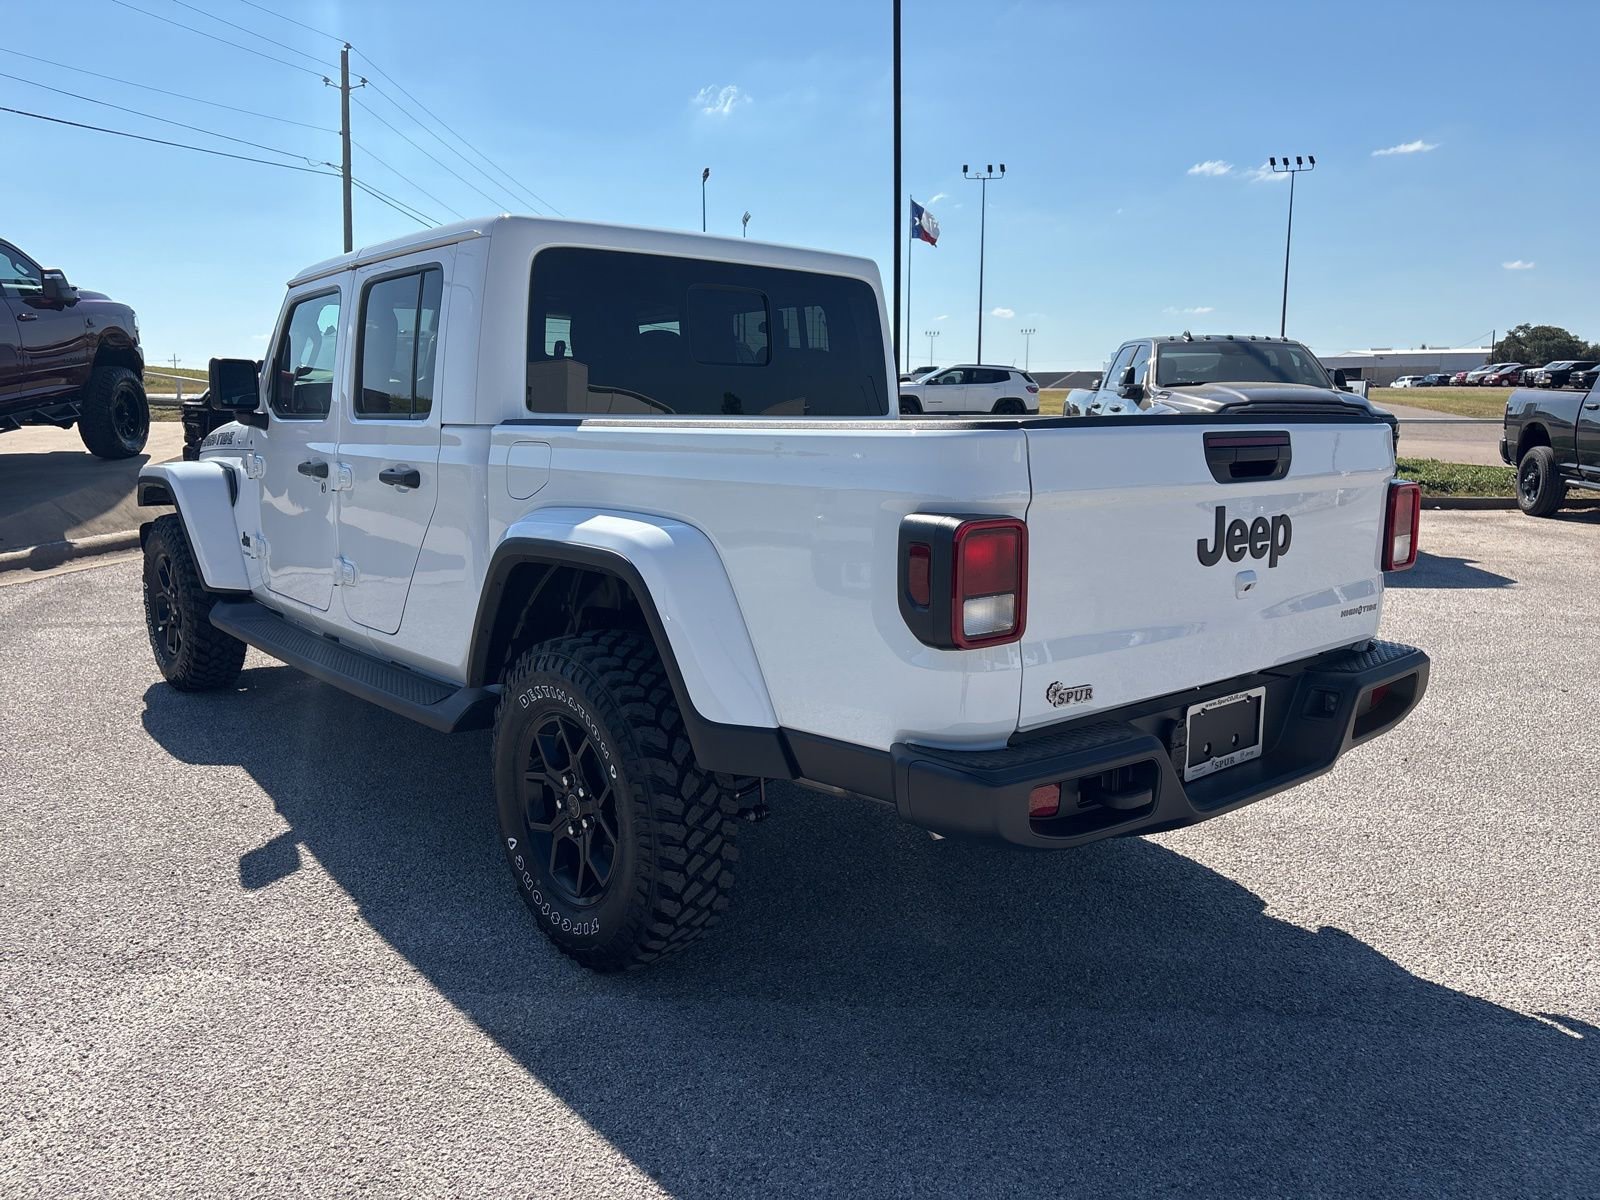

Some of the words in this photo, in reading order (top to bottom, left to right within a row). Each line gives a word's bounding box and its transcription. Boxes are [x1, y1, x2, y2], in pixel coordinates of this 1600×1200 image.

[1197, 505, 1293, 569] Jeep
[1057, 688, 1094, 705] SPUR
[519, 685, 610, 759] DESTINATION
[1214, 756, 1236, 770] SPUR
